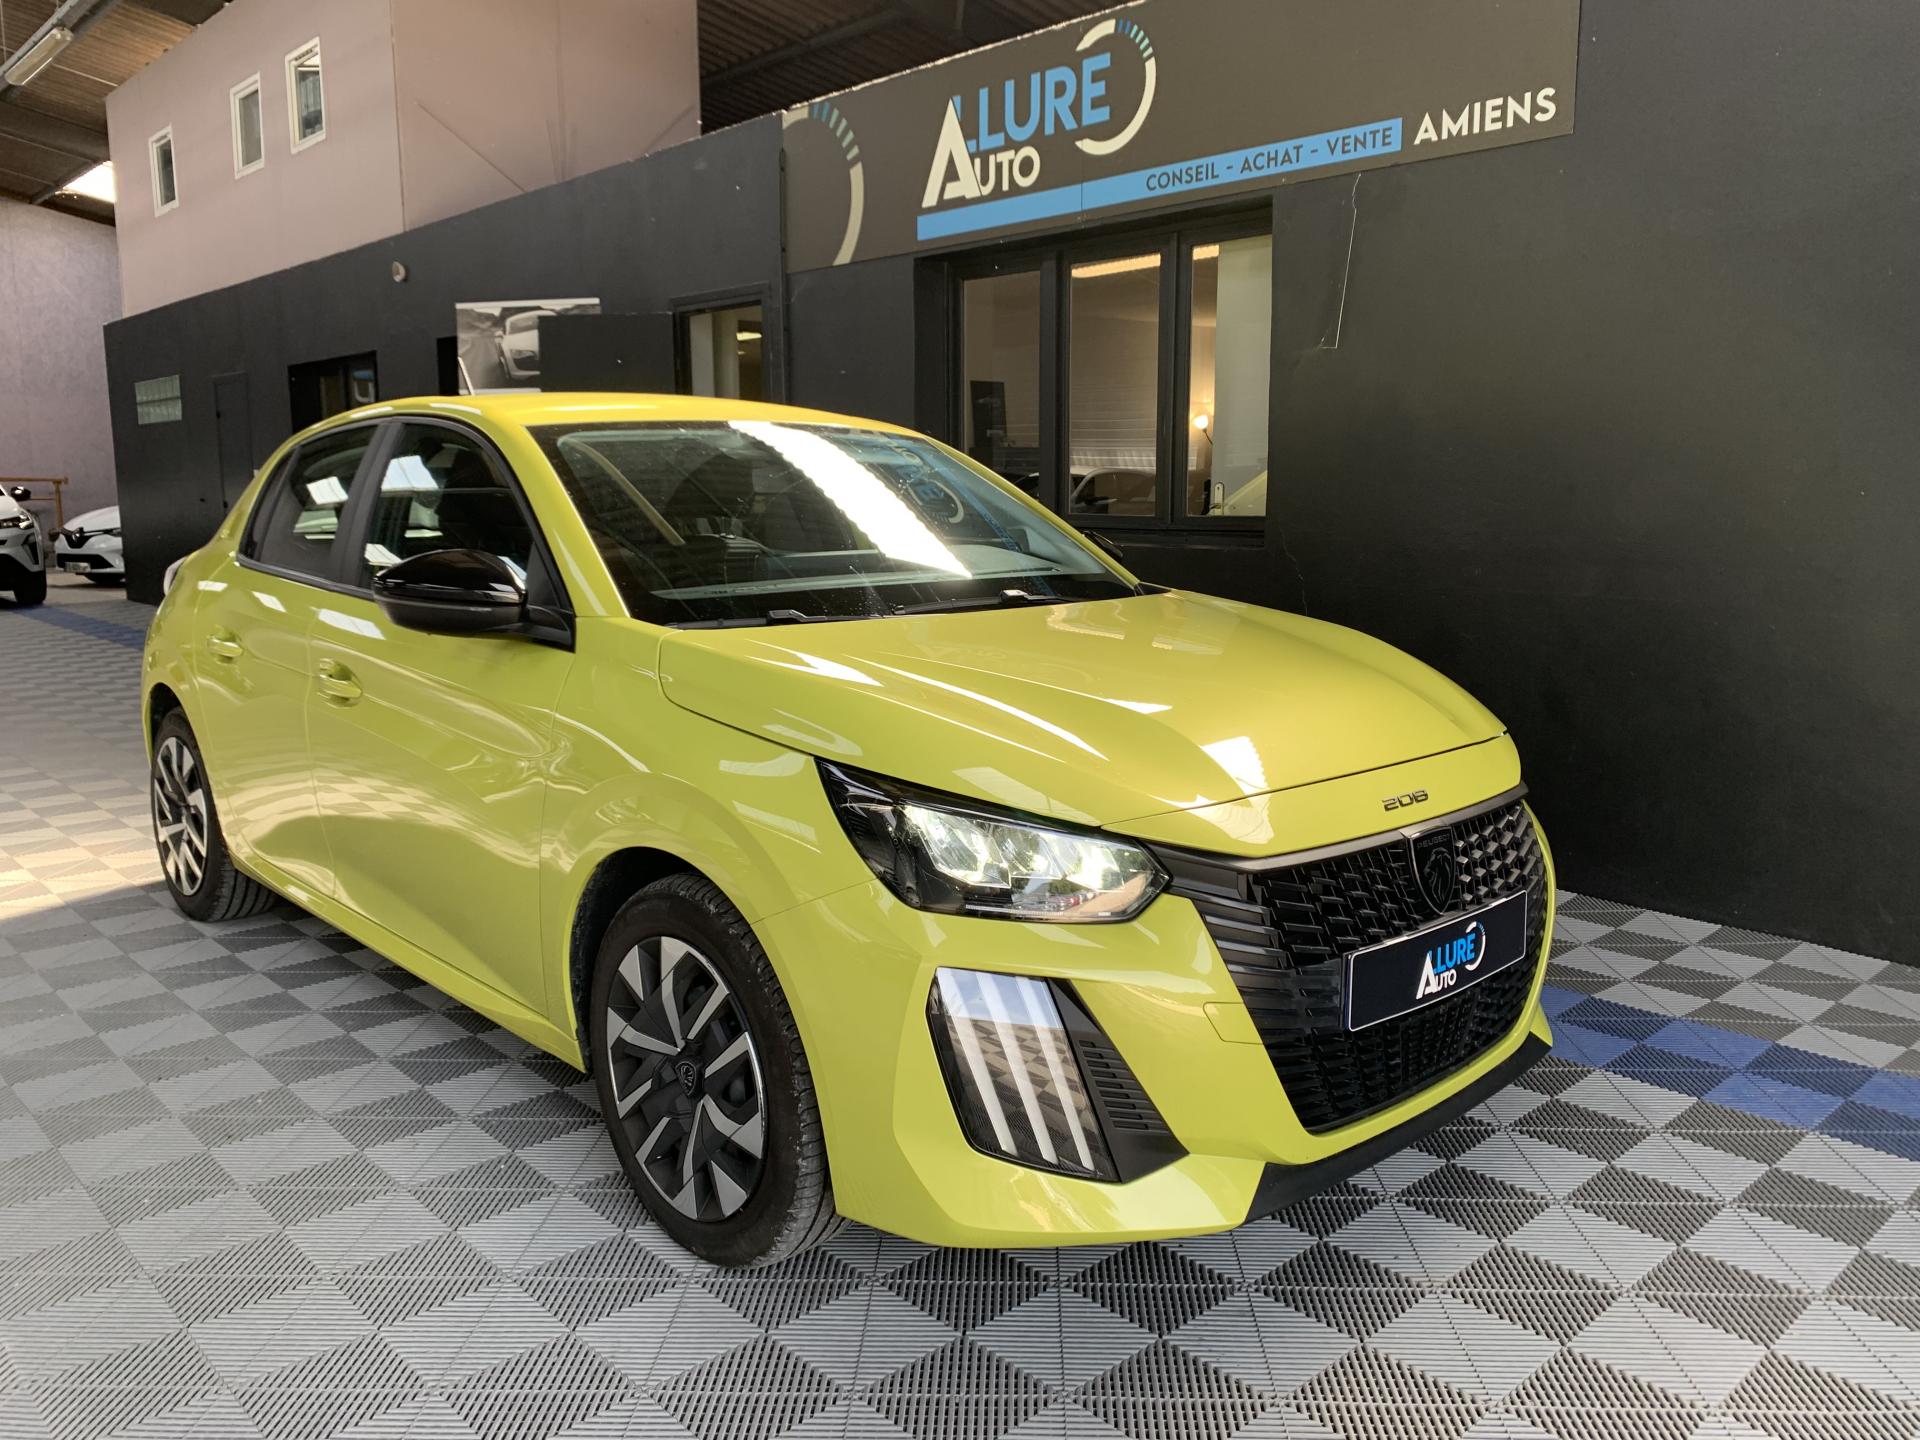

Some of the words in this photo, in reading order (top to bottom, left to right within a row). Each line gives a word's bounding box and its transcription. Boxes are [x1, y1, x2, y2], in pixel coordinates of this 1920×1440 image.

[1413, 87, 1557, 145] AMIENS
[1146, 162, 1219, 191] CONSEIL
[1240, 145, 1304, 174] ACHAT
[1326, 127, 1393, 156] VENTE
